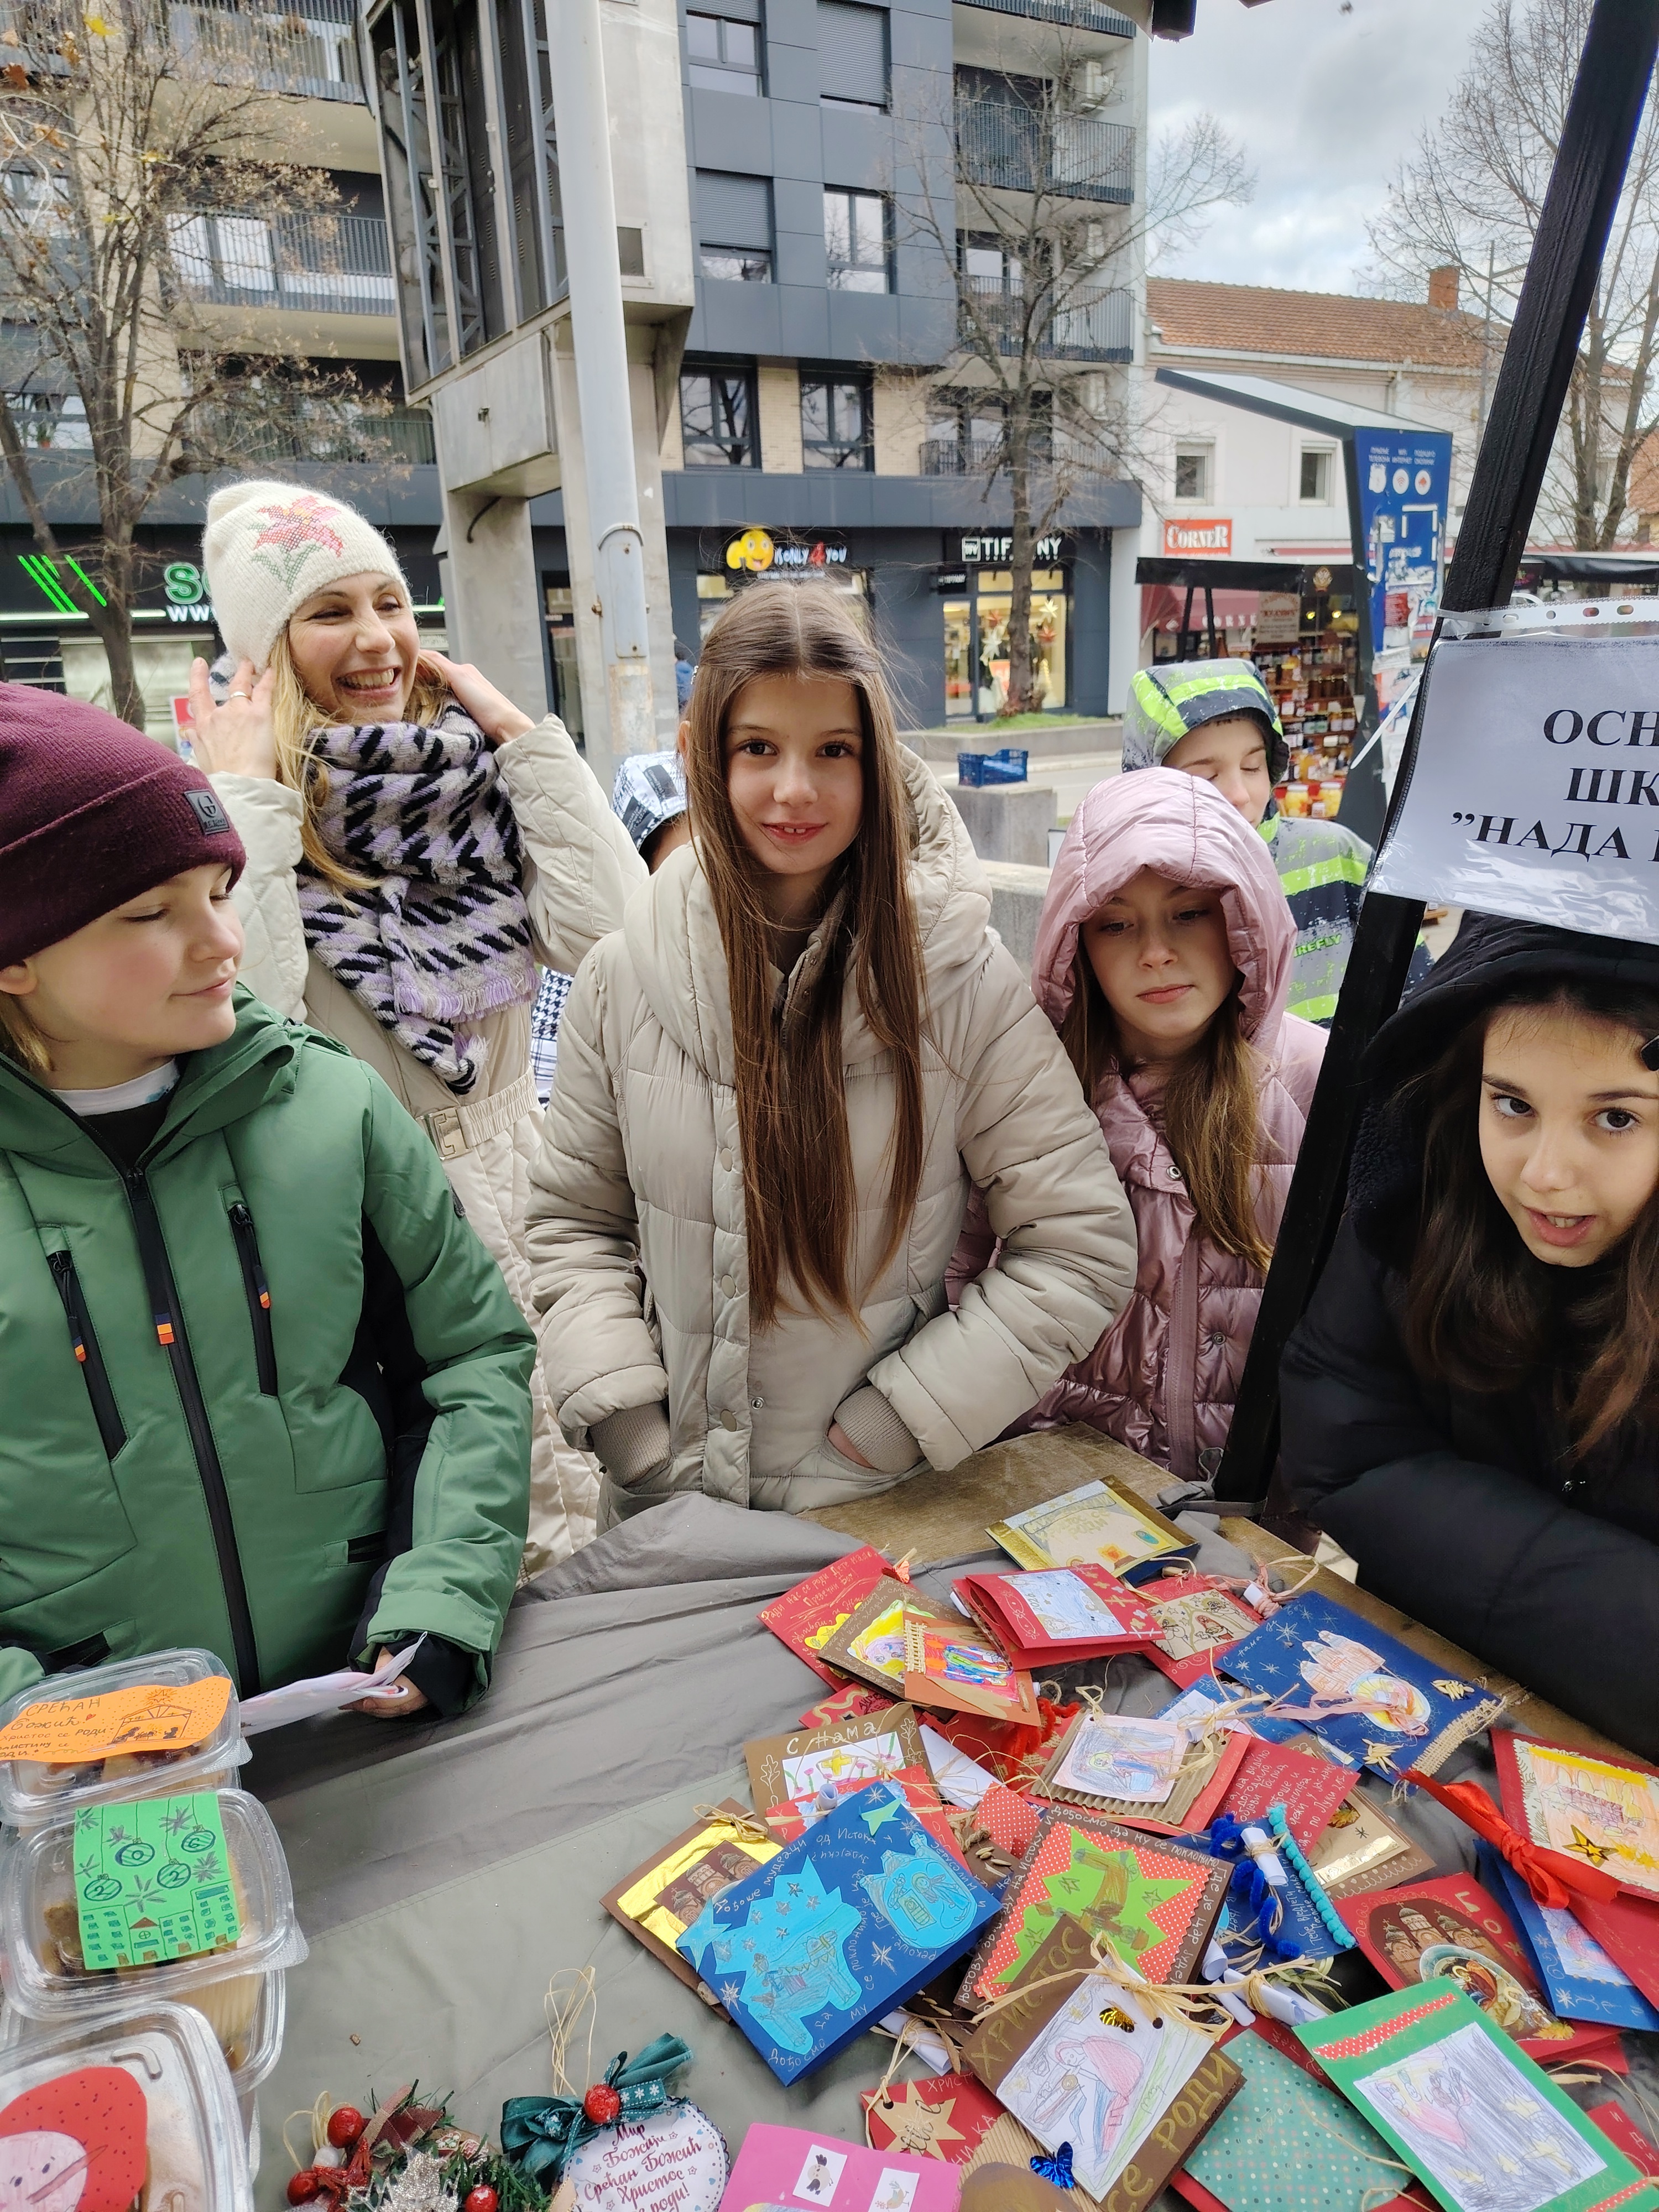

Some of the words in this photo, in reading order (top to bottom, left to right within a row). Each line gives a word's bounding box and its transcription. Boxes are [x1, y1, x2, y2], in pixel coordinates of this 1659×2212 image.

[826, 546, 847, 565] YOU
[164, 562, 212, 604] S
[26, 1697, 100, 1717] СРЕЋАН
[1151, 2051, 1239, 2154] РОДИ
[612, 2122, 646, 2147] Мир
[584, 2169, 639, 2205] Срећан
[641, 2136, 702, 2172] Божић
[617, 2168, 685, 2206] Христос
